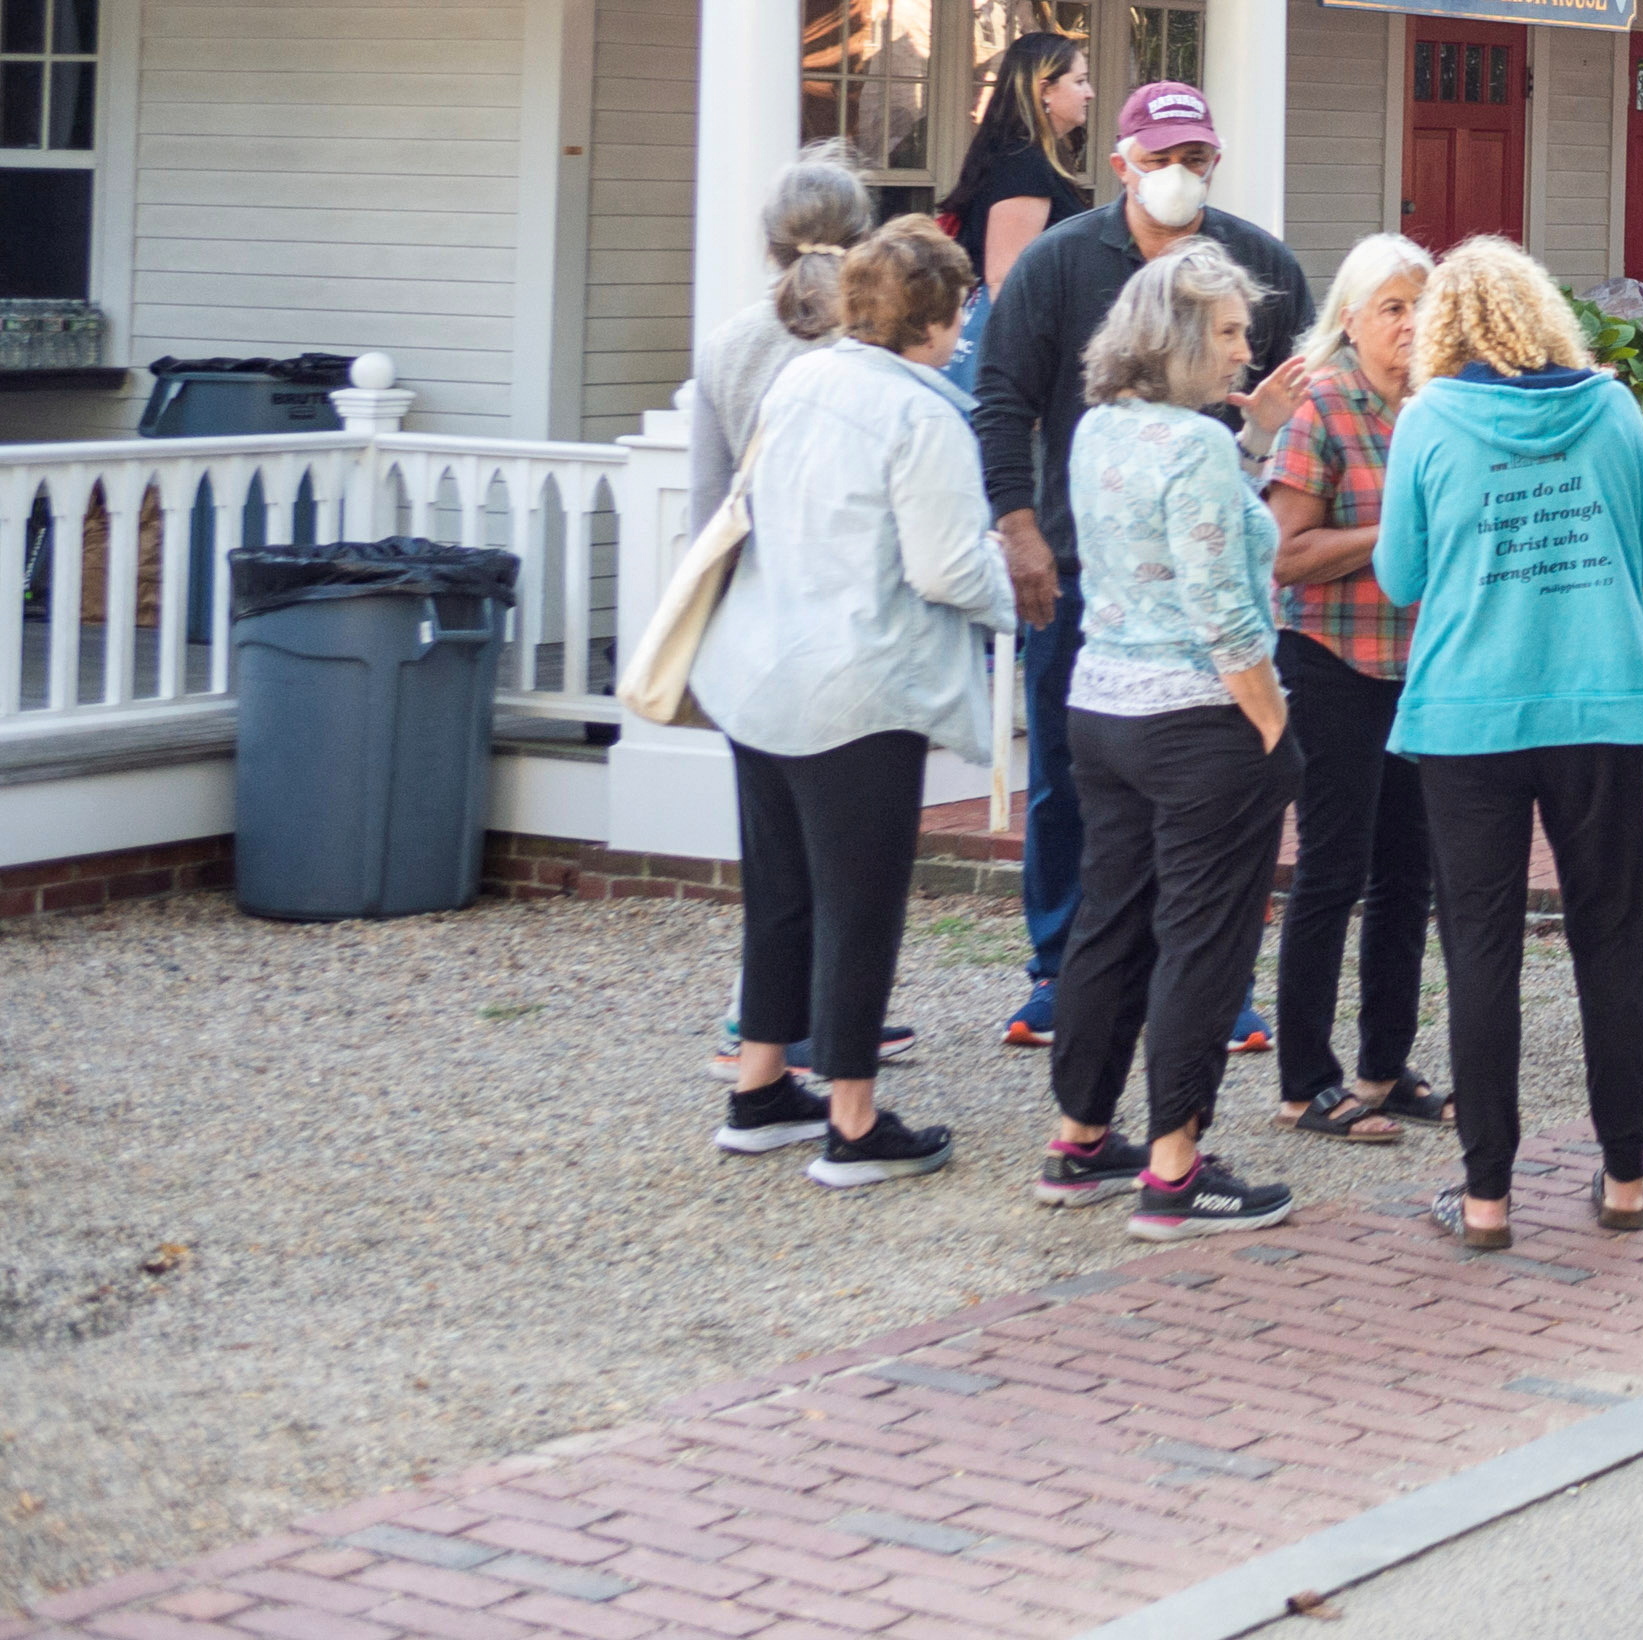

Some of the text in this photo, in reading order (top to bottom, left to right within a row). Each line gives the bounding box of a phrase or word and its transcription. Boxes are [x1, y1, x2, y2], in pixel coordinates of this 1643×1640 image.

[1482, 476, 1582, 507] I can do all
[1477, 501, 1603, 535] things through
[1496, 531, 1589, 557] Christ who
[1478, 554, 1613, 586] strengthens me.
[1192, 1192, 1243, 1212] HOKA
